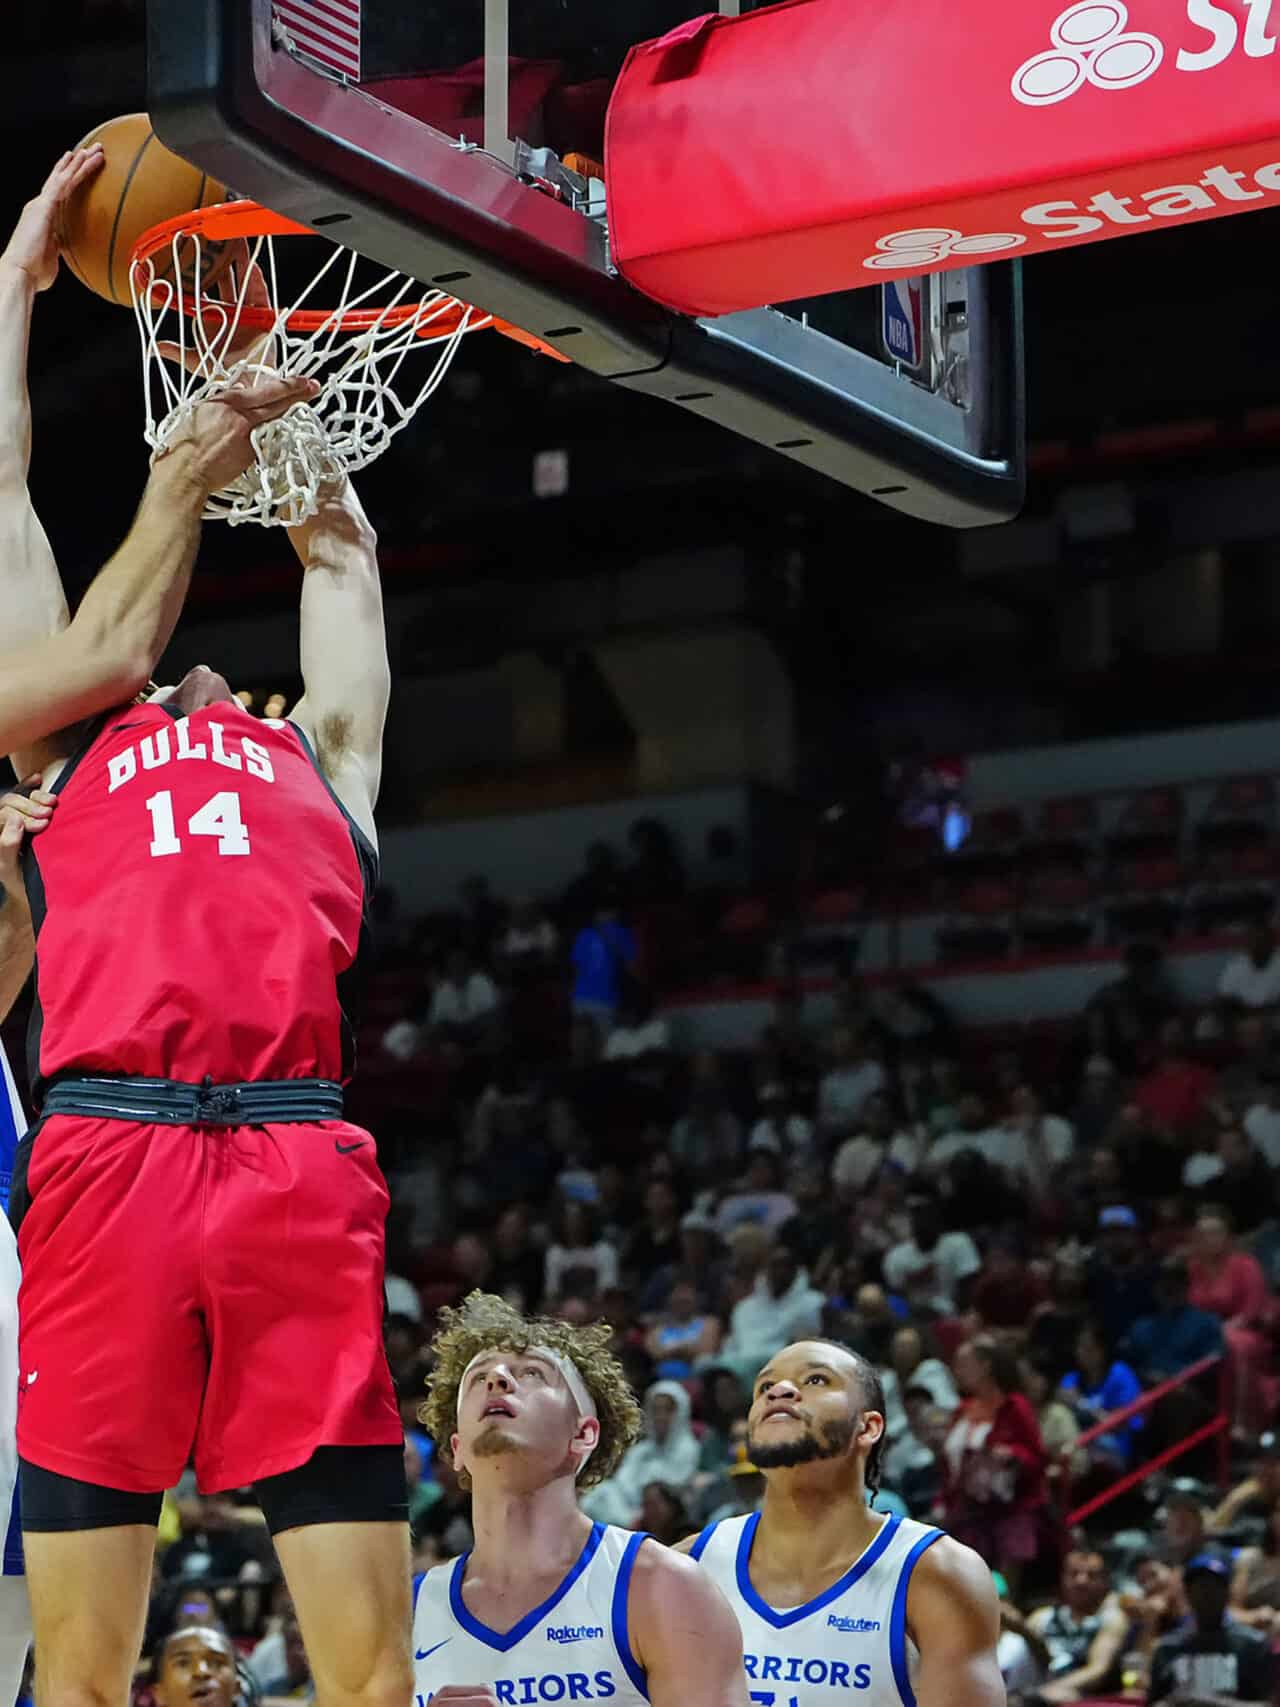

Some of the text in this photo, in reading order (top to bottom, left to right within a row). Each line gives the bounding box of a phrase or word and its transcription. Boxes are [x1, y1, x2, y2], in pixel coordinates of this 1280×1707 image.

[887, 314, 909, 353] NBA
[107, 716, 275, 794] BULLS
[146, 790, 251, 857] 14
[546, 1625, 604, 1644] Rakuten
[827, 1614, 881, 1632] Rakuten
